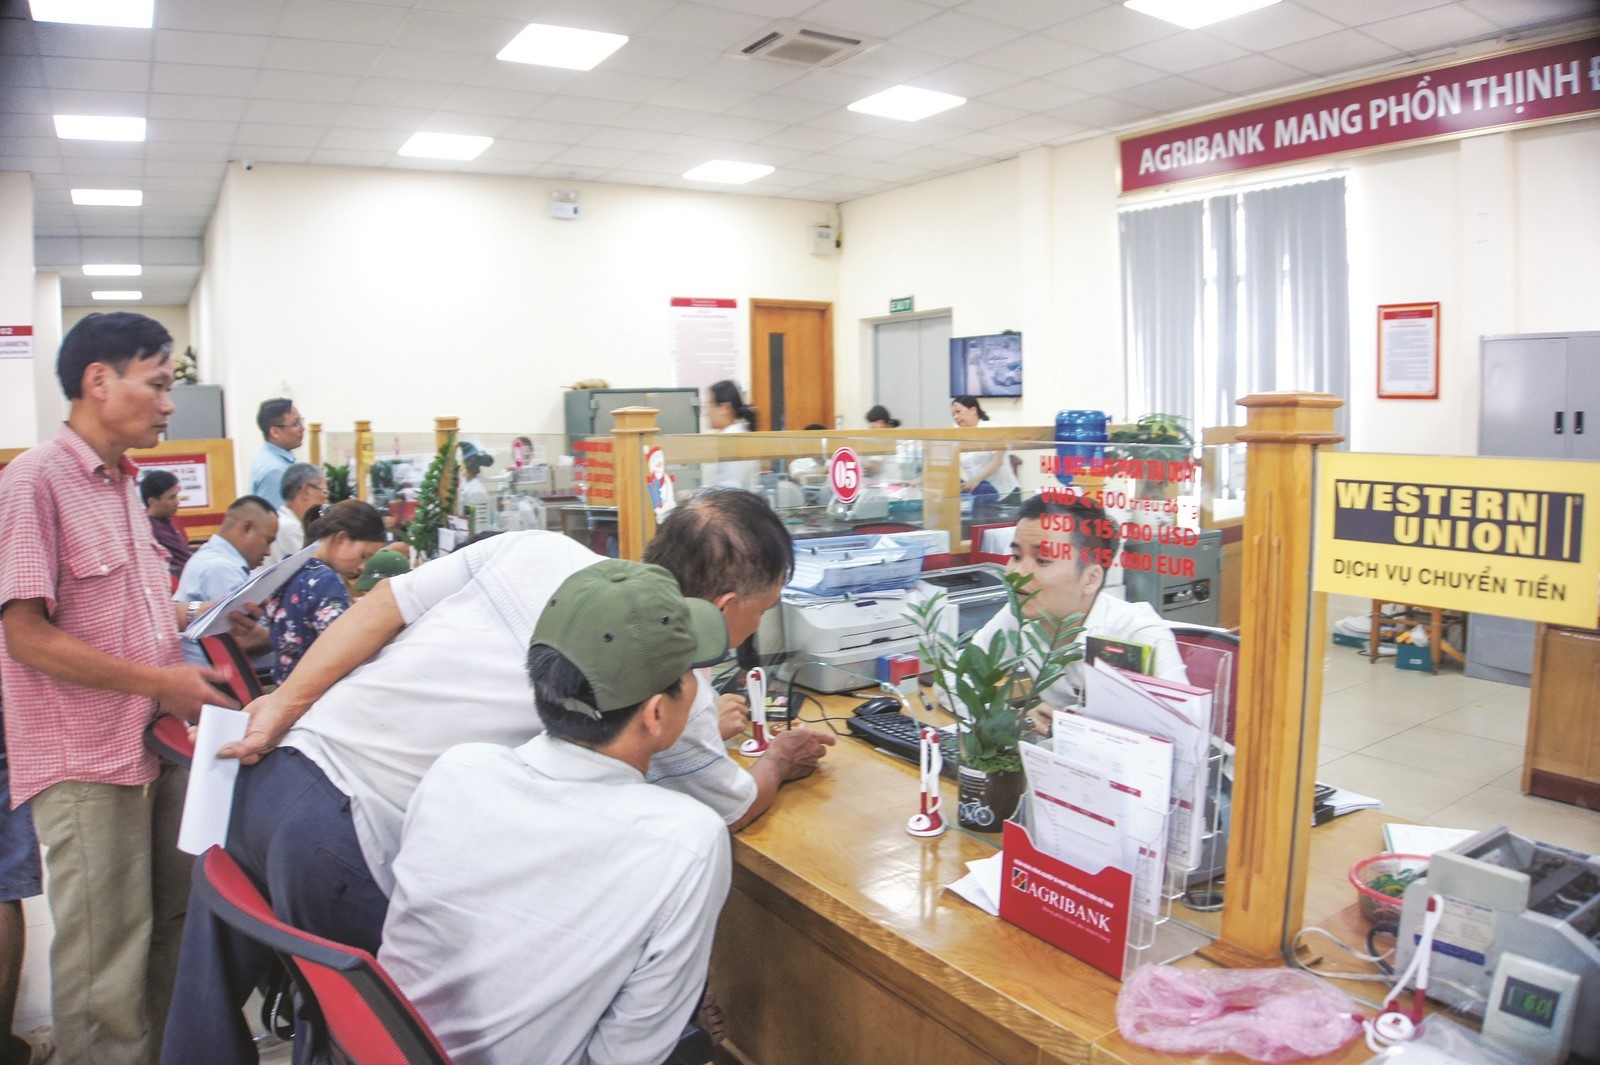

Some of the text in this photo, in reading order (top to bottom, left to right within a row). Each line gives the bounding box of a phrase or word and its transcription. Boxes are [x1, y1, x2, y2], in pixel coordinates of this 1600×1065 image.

[1139, 123, 1265, 176] AGRIBANK
[1274, 103, 1363, 149] MANG
[1369, 75, 1461, 130] PHỒN
[1466, 60, 1581, 114] THỊNH
[834, 460, 857, 489] 05
[1096, 490, 1126, 509] 500
[1040, 514, 1075, 533] USD
[1094, 519, 1153, 542] 15.000
[1158, 525, 1199, 547] USD
[1336, 482, 1538, 556] WESTERN UNION
[1040, 541, 1072, 560] EUR
[1094, 547, 1153, 572] 15.000
[1157, 555, 1195, 578] EUR
[1333, 559, 1378, 579] DỊCH
[1385, 564, 1411, 586] VỤ
[1418, 566, 1506, 594] CHUYỂN
[1027, 882, 1111, 932] AGRIBANK
